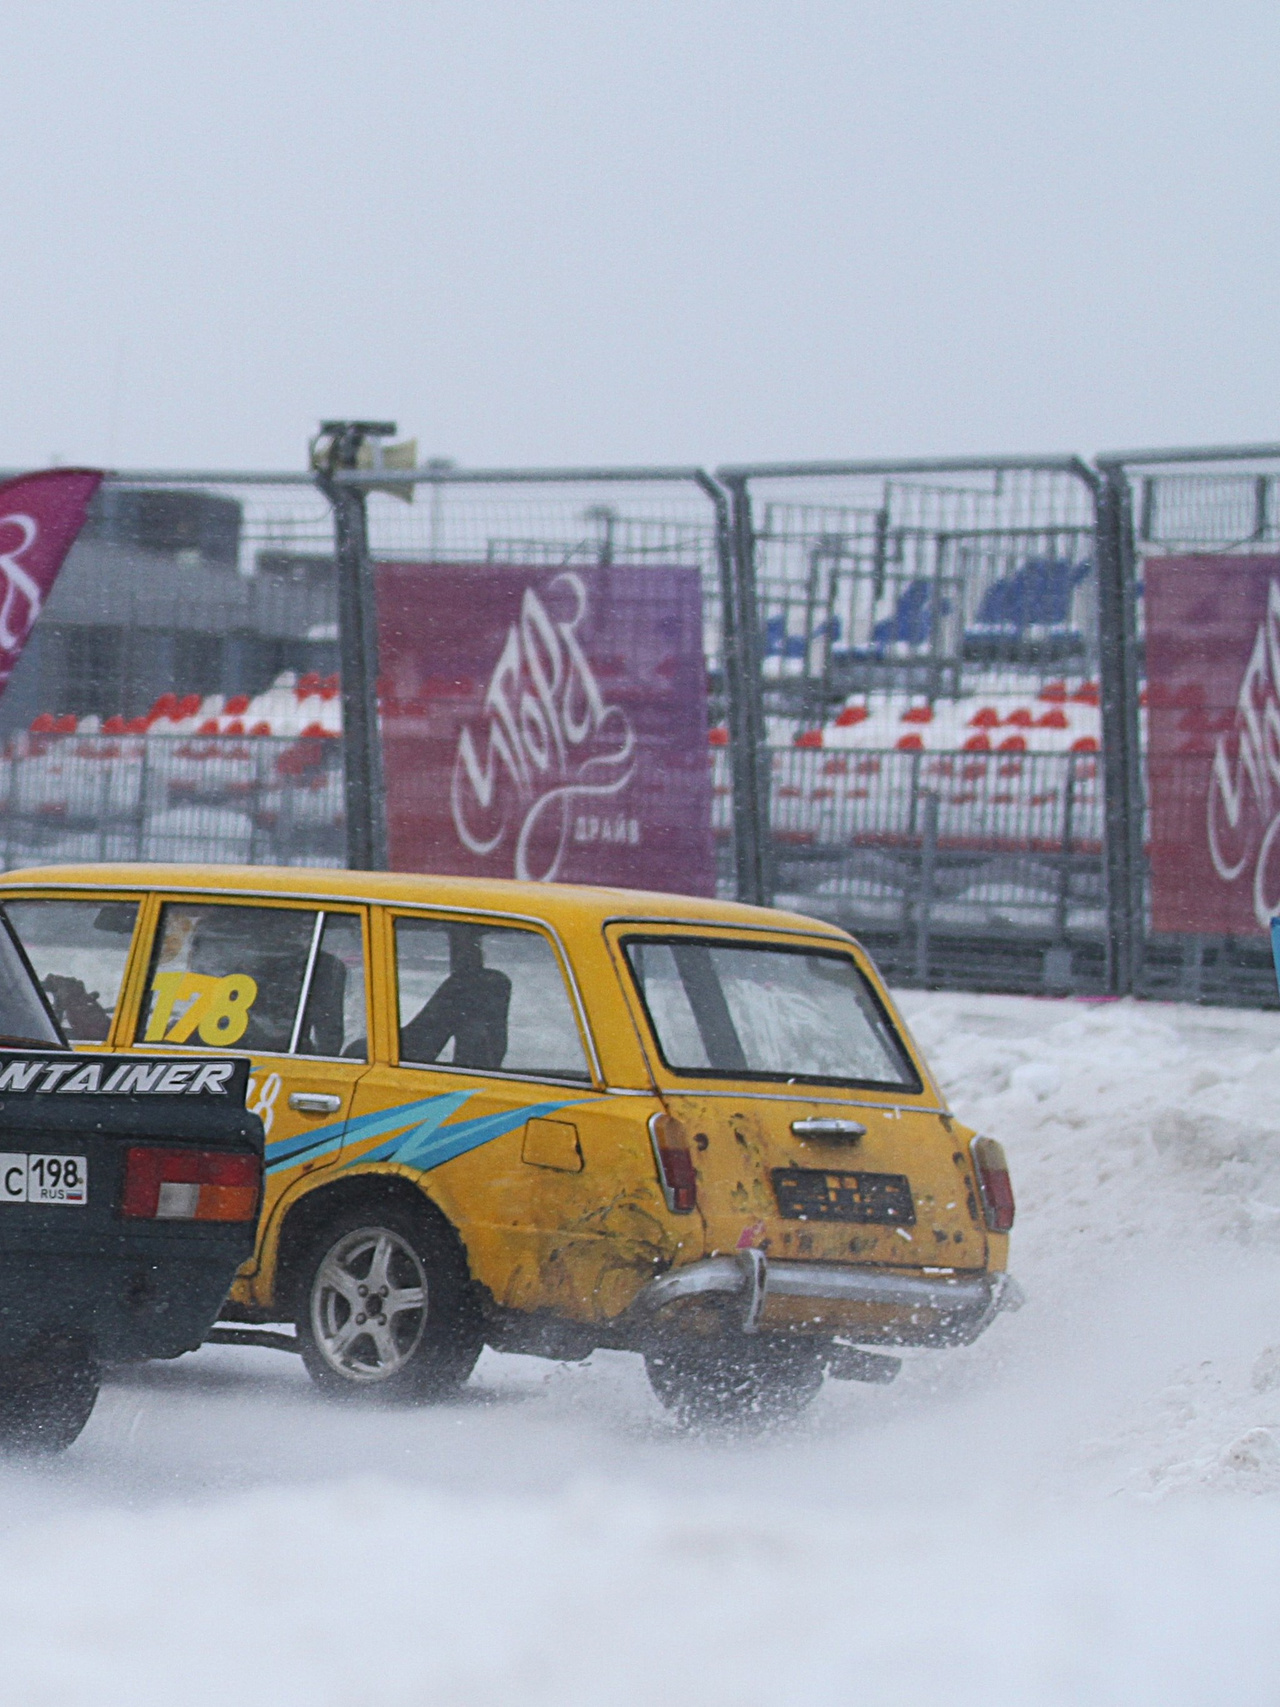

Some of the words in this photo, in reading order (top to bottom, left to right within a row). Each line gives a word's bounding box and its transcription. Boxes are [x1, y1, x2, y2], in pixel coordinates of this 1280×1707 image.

[144, 971, 258, 1046] 178
[31, 1157, 79, 1188] 198
[40, 1188, 65, 1199] RUS
